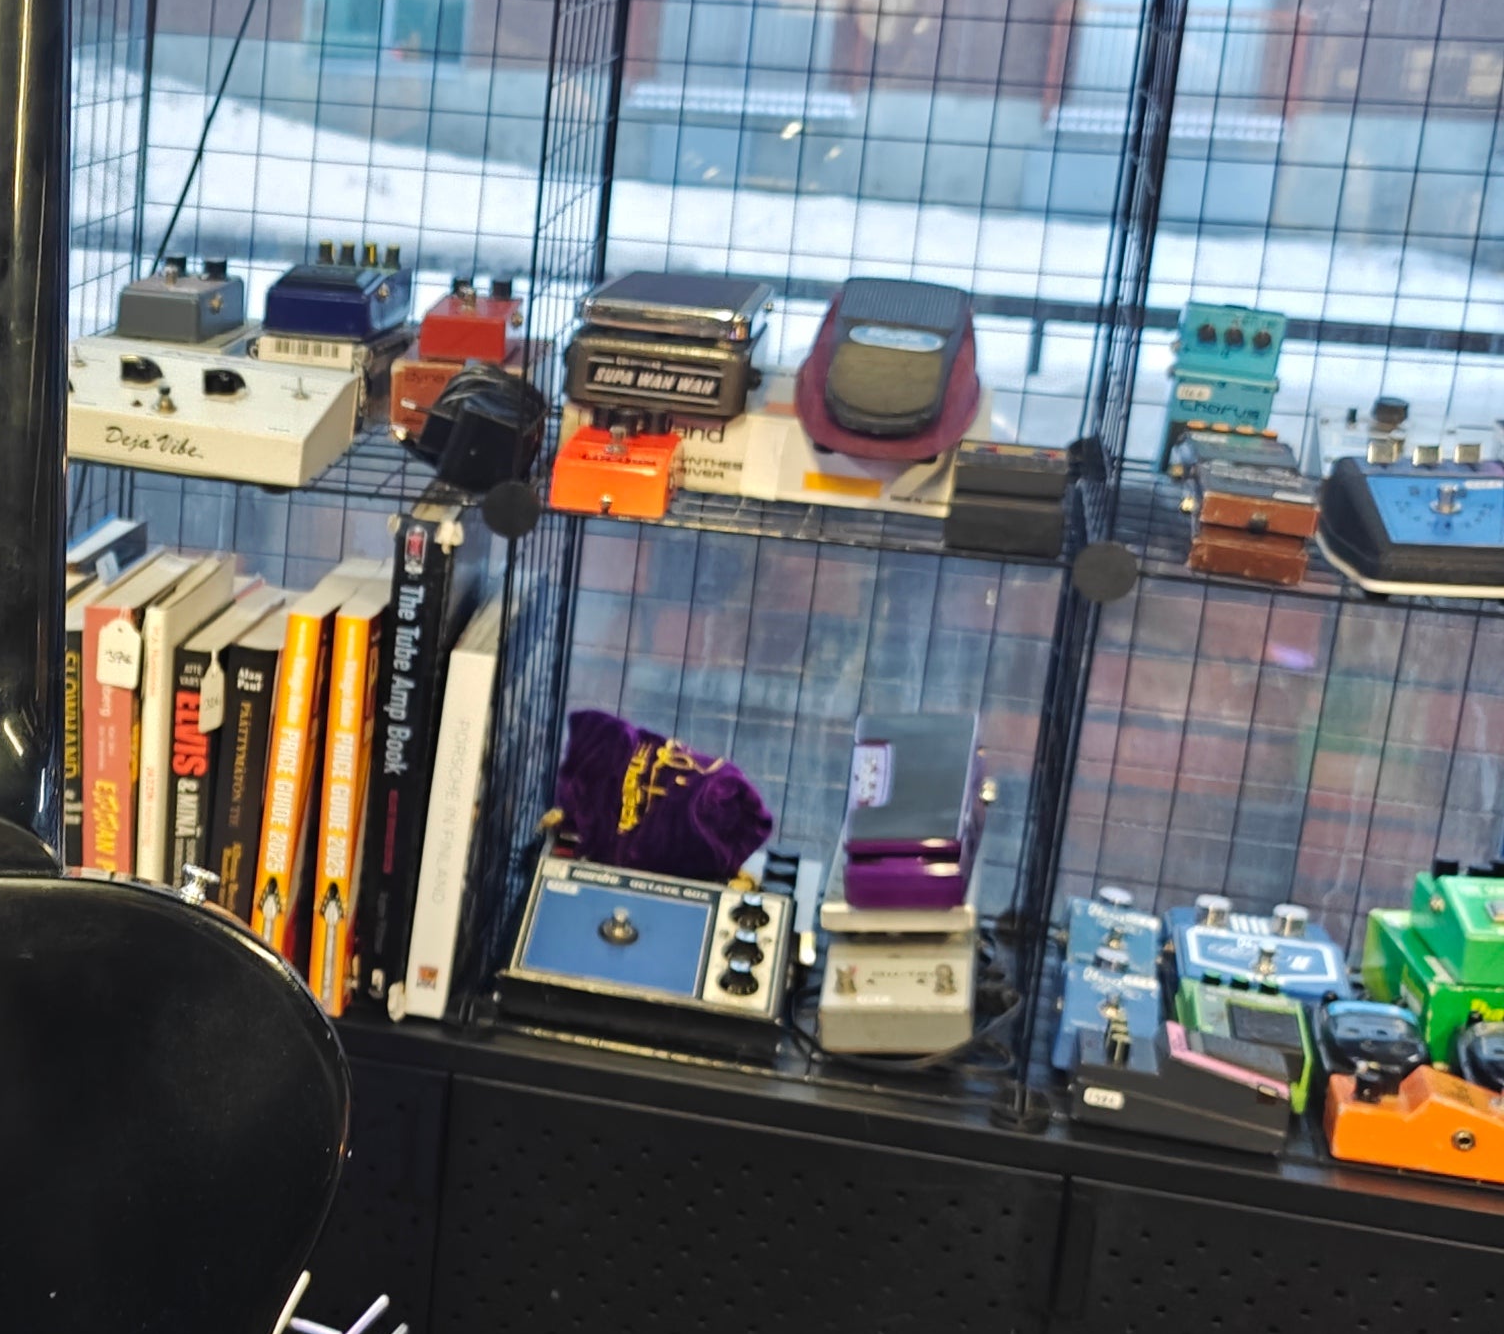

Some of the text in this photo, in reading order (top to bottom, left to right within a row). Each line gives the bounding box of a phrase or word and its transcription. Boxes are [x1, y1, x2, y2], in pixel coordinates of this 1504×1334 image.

[594, 367, 716, 395] SUPA WAH WAH
[157, 433, 204, 459] Vibe
[397, 584, 425, 621] The
[393, 626, 422, 672] Tube
[237, 679, 264, 693] Paul
[238, 667, 264, 681] Alan
[383, 674, 416, 721] Amp
[172, 690, 210, 778] ELVIS
[276, 727, 302, 777] PRICE
[331, 731, 356, 780] PRICE
[384, 723, 412, 775] Book
[176, 777, 199, 794] &
[269, 778, 294, 828] GUIDE
[328, 783, 352, 833] GUIDE
[432, 718, 471, 905] PORSCHE IN FINLAND
[265, 830, 288, 875] 2025
[325, 834, 347, 878] 2025
